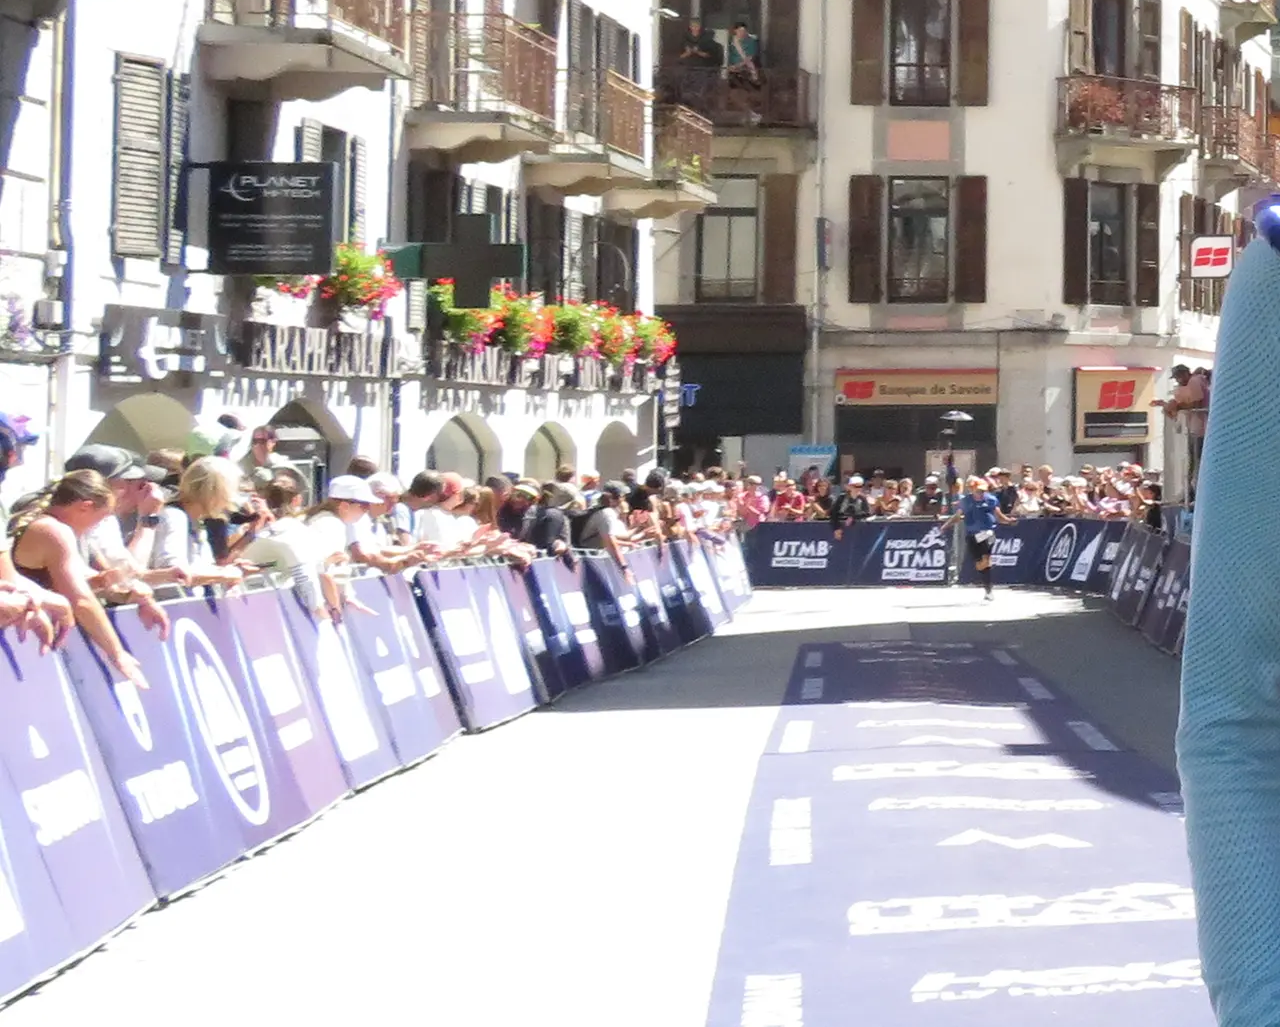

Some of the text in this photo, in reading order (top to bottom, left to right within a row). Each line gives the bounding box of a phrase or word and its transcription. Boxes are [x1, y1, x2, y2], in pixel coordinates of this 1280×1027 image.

[240, 176, 321, 187] PLANET
[262, 189, 321, 198] HI-TECH
[878, 383, 992, 398] Banque de Savoie
[774, 540, 830, 557] UTMB
[991, 538, 1022, 554] TMB
[883, 549, 946, 568] UTMB
